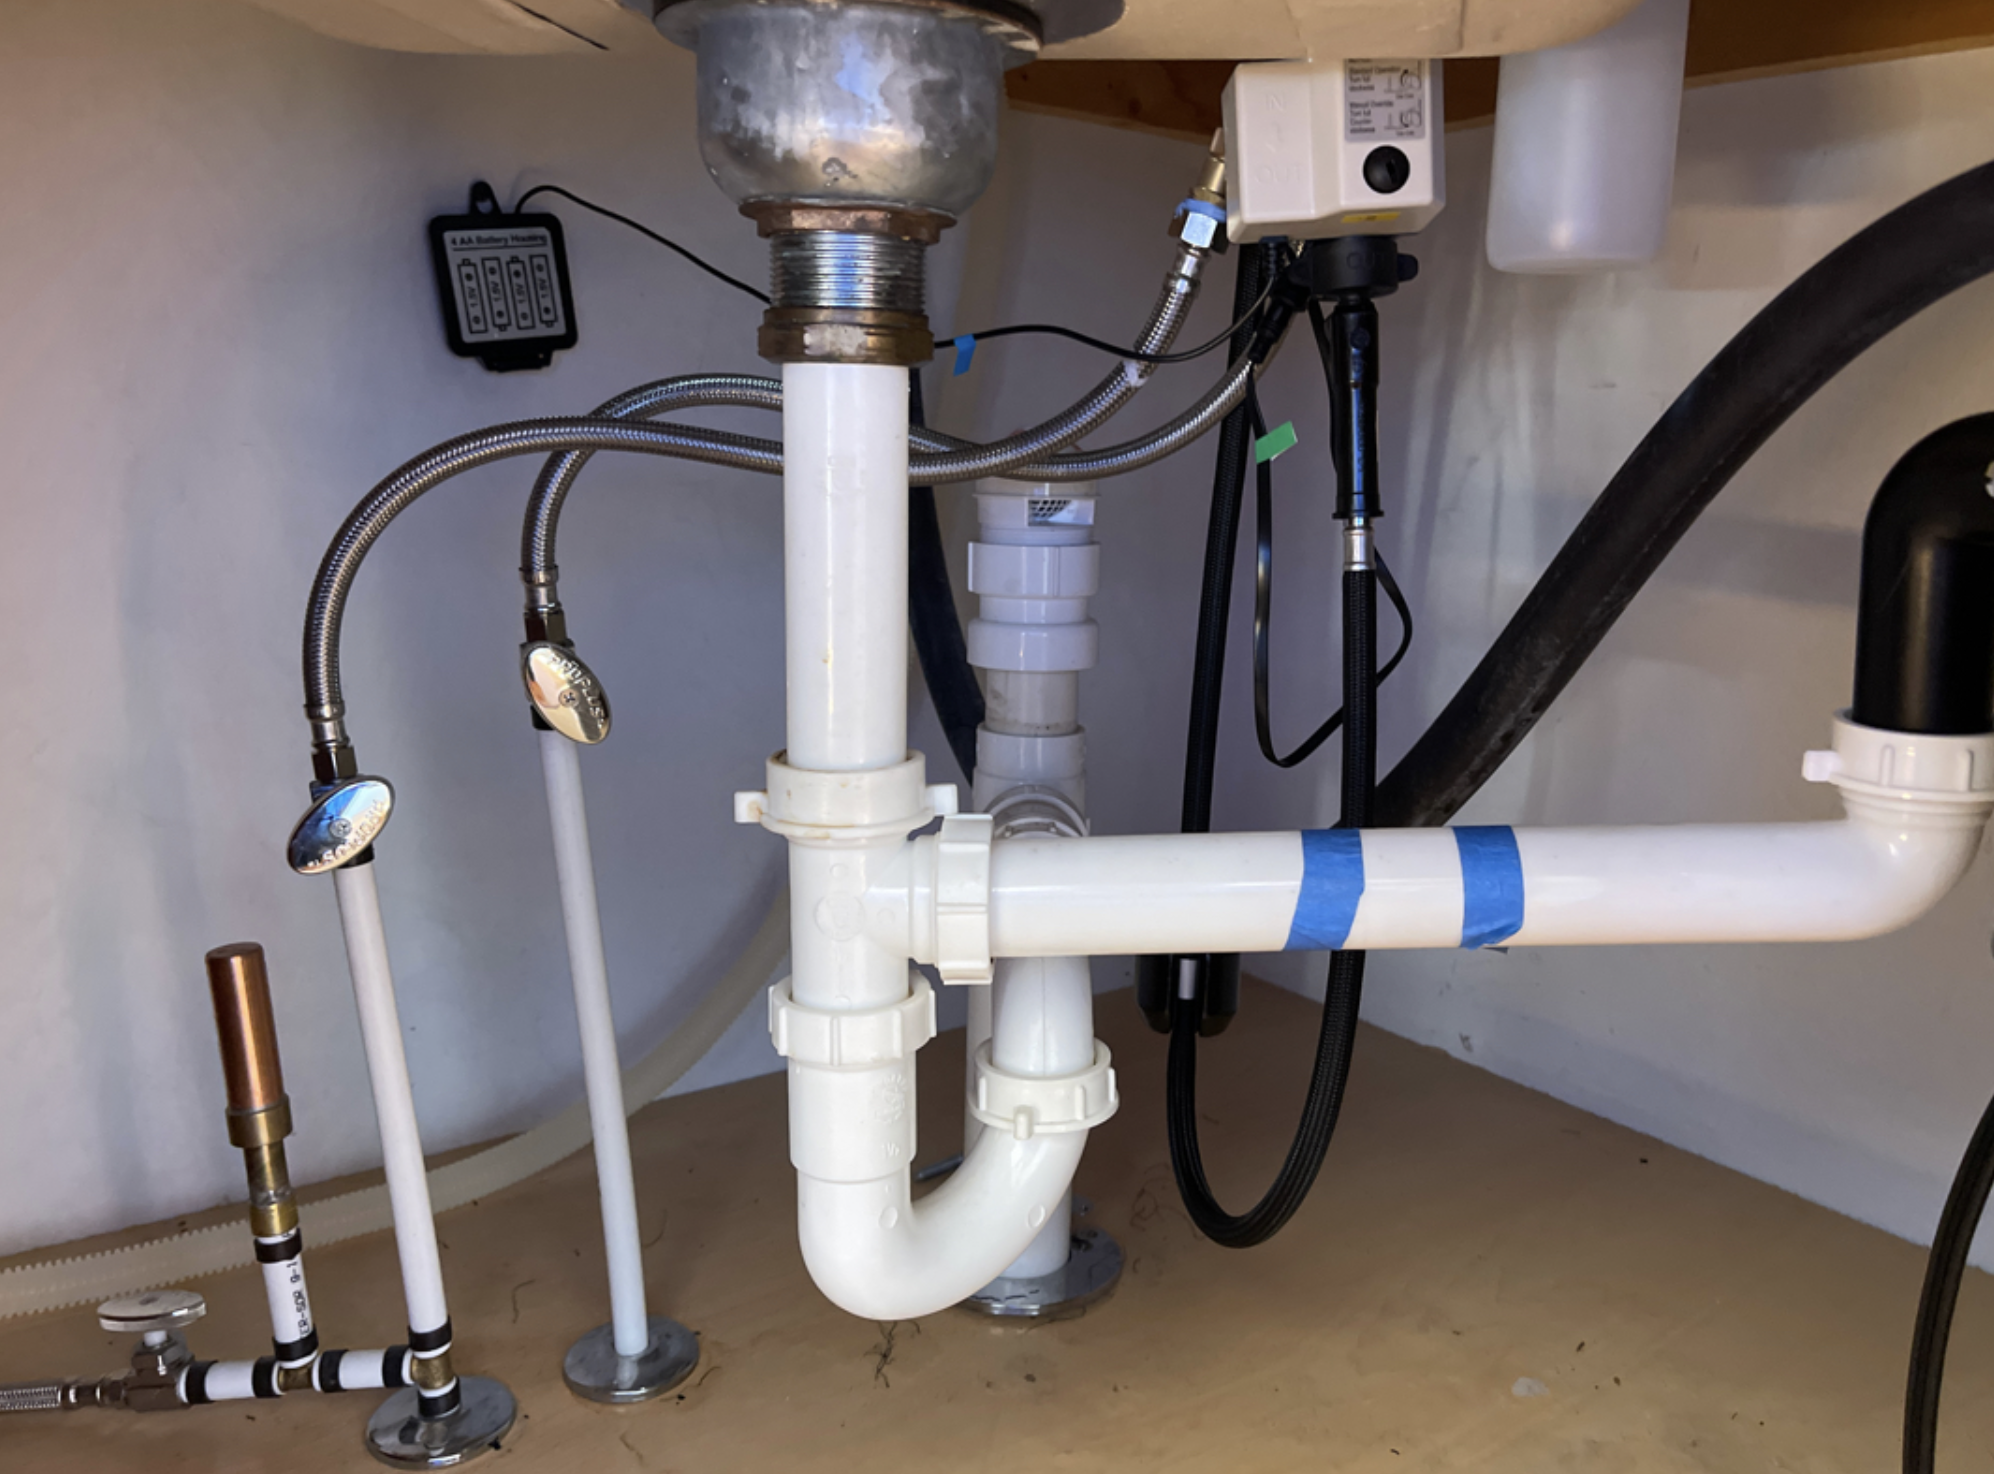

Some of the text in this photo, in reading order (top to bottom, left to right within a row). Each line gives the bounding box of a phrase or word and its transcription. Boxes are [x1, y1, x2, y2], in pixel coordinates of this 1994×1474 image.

[460, 235, 475, 246] AA
[476, 234, 509, 247] Battery
[511, 232, 548, 247] Housing
